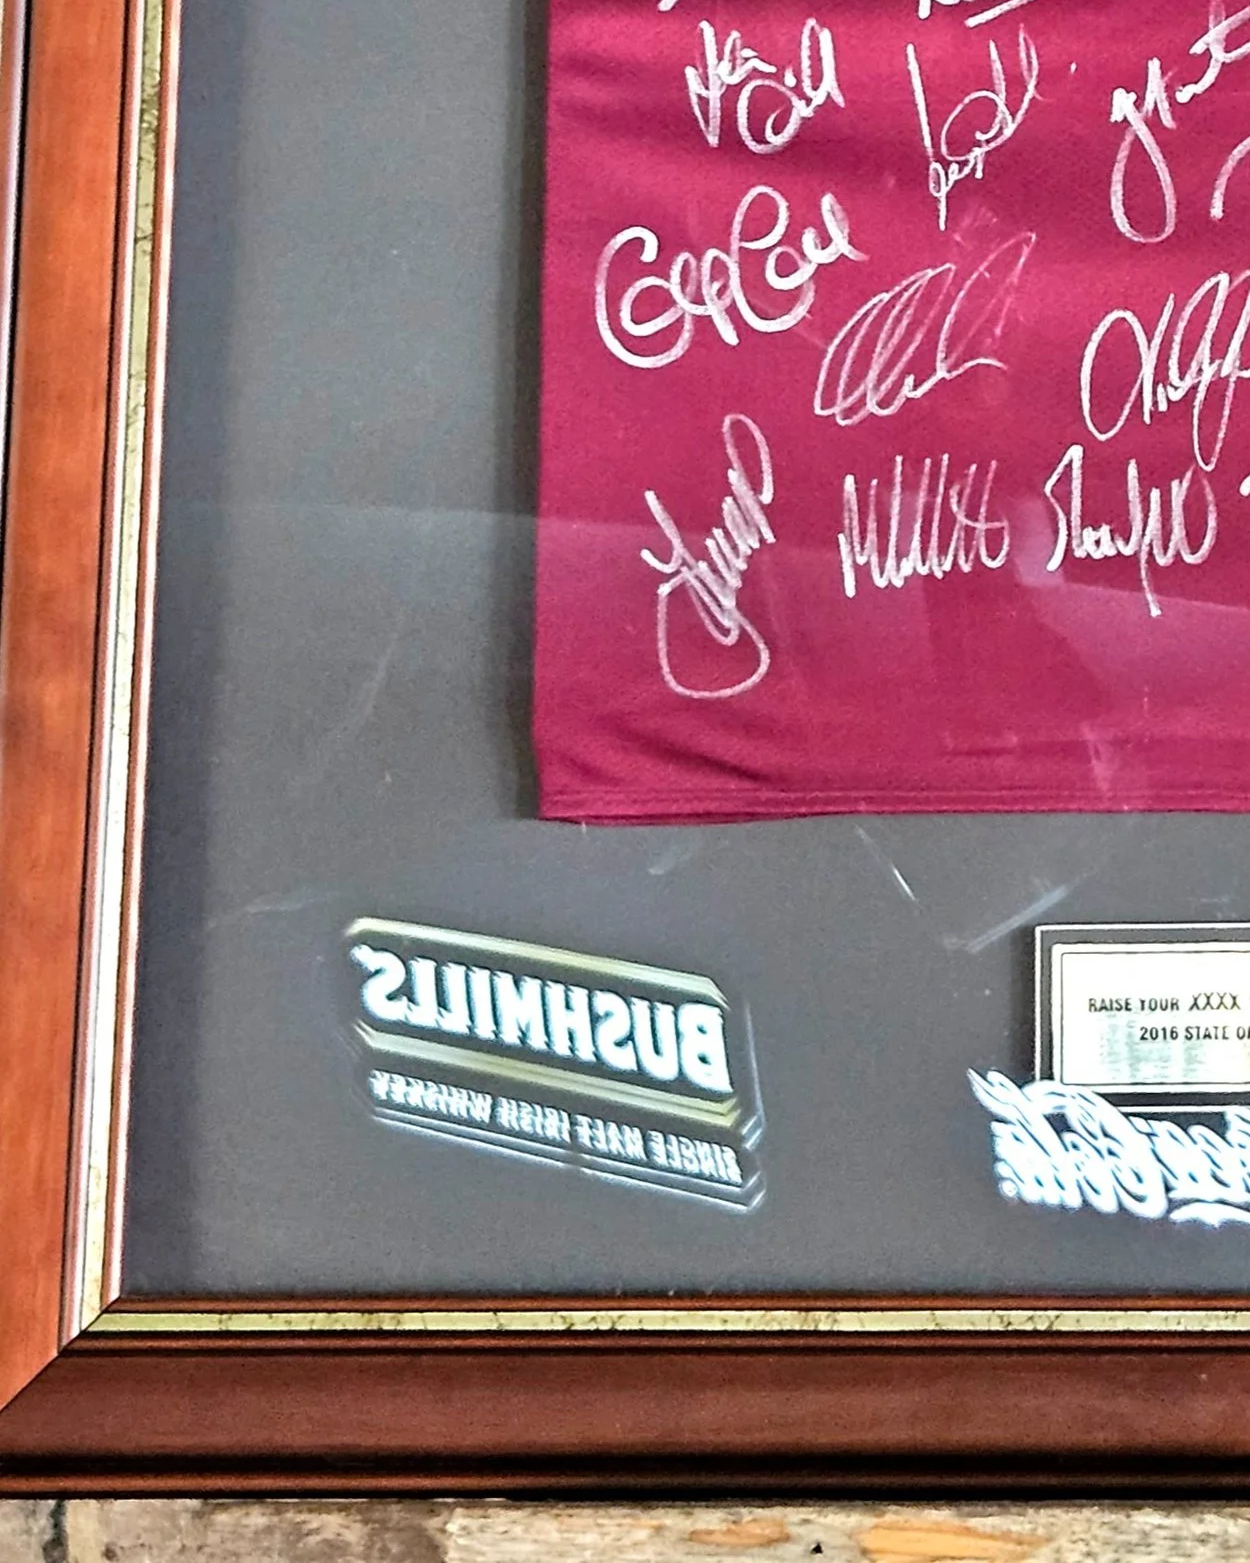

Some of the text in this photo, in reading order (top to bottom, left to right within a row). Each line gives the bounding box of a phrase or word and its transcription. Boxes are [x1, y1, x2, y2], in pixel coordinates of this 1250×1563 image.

[1088, 996, 1132, 1012] RAISE
[1138, 996, 1179, 1011] YOUR
[1188, 992, 1241, 1011] XXXX
[1139, 1025, 1179, 1041] 2016
[1184, 1024, 1230, 1040] STATE
